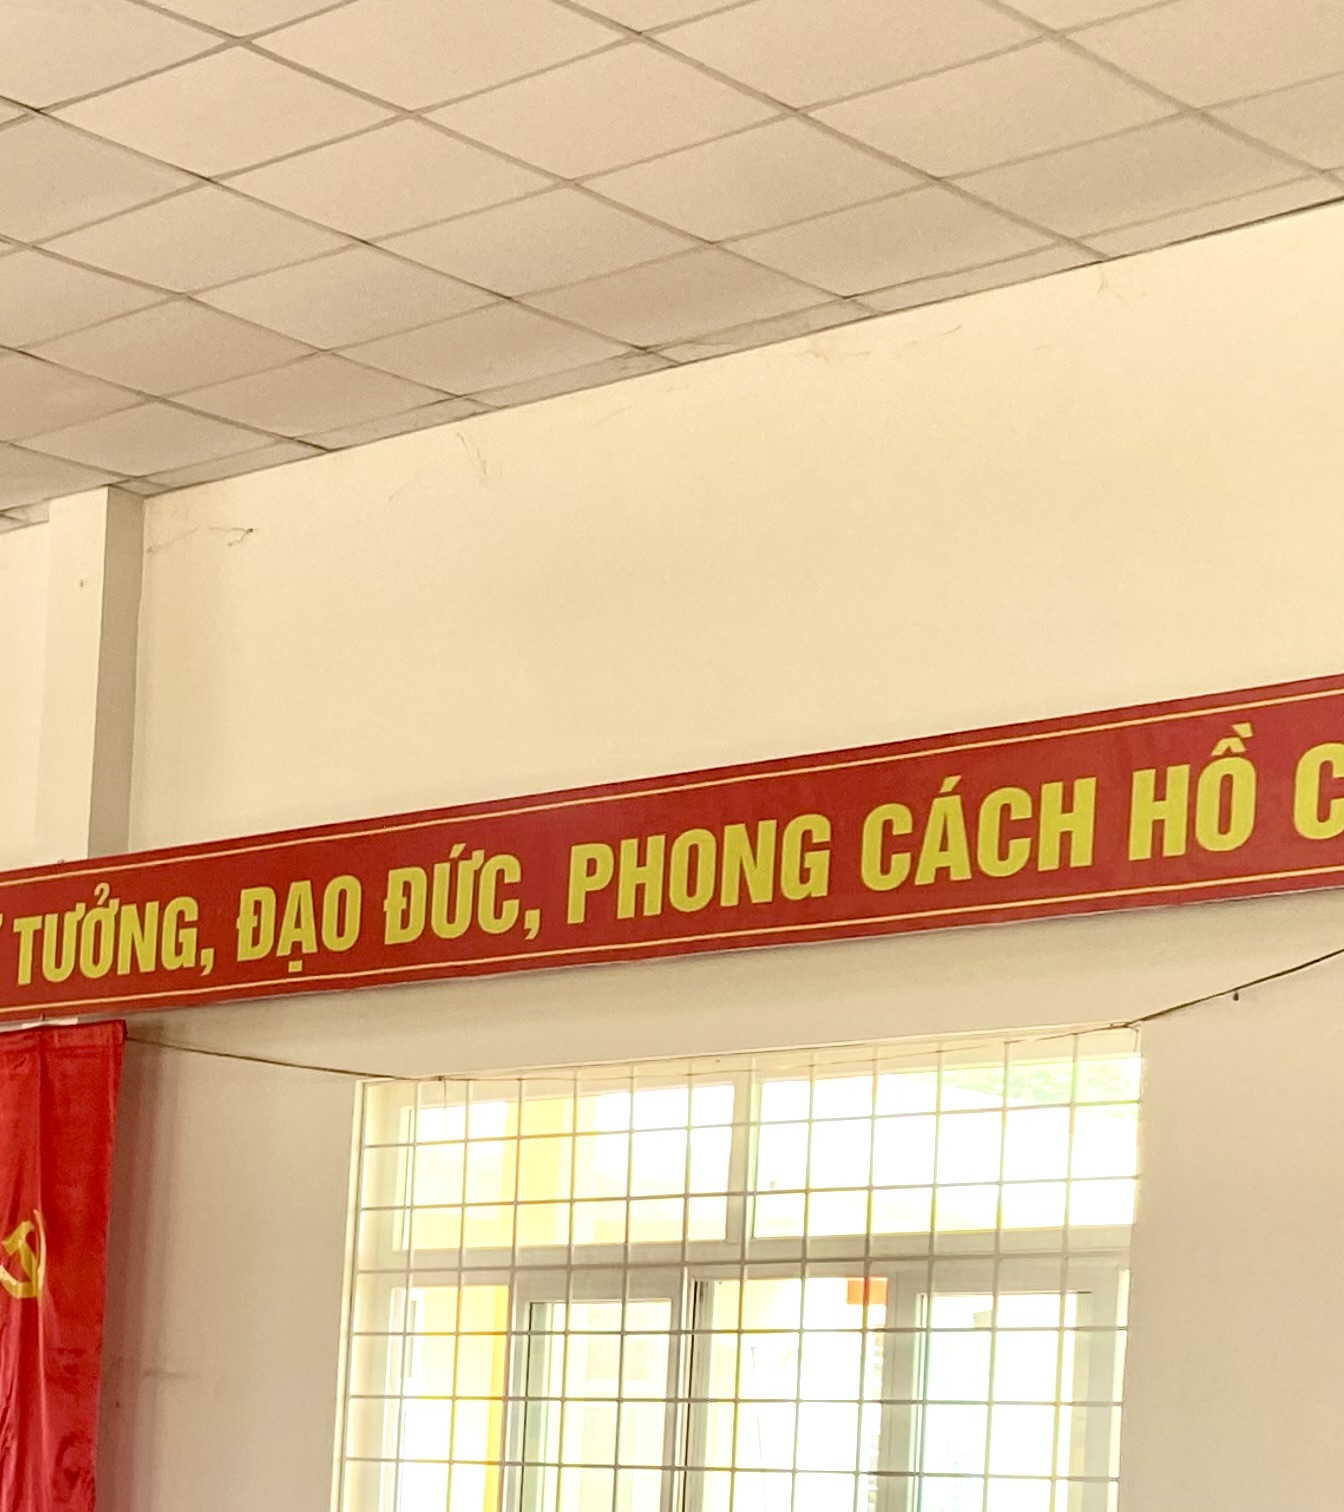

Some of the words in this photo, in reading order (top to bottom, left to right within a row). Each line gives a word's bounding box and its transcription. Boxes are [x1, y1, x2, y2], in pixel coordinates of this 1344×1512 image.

[13, 883, 214, 985] TƯỞNG,
[236, 875, 362, 973] ĐẠO
[383, 843, 540, 945] ĐỨC,
[567, 813, 832, 924] PHONG
[860, 776, 1097, 891] CÁCH
[1128, 722, 1258, 862] HỒ
